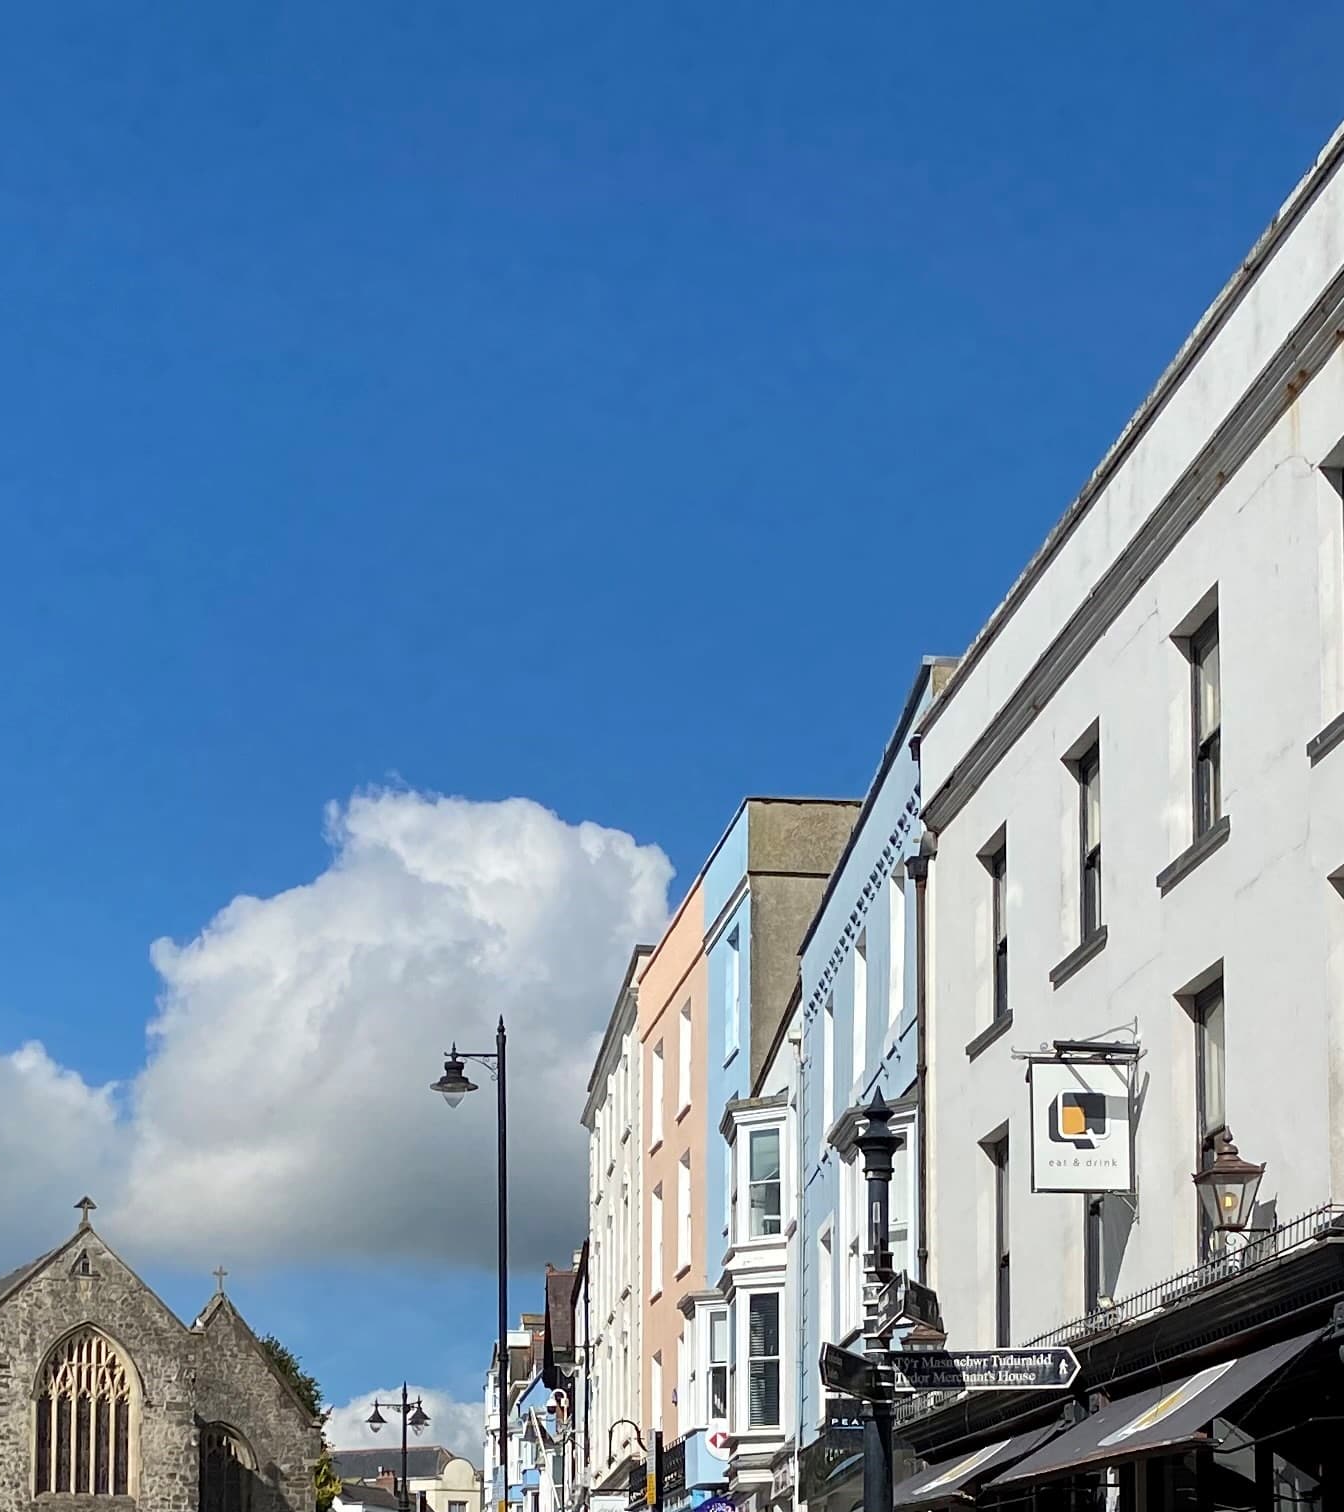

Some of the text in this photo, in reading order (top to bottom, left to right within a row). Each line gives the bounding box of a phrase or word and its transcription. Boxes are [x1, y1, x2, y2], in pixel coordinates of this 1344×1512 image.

[1048, 1158, 1119, 1168] eat & drink
[921, 1355, 989, 1369] Masnachwr
[895, 1370, 1036, 1385] Tudor Merchant's House
